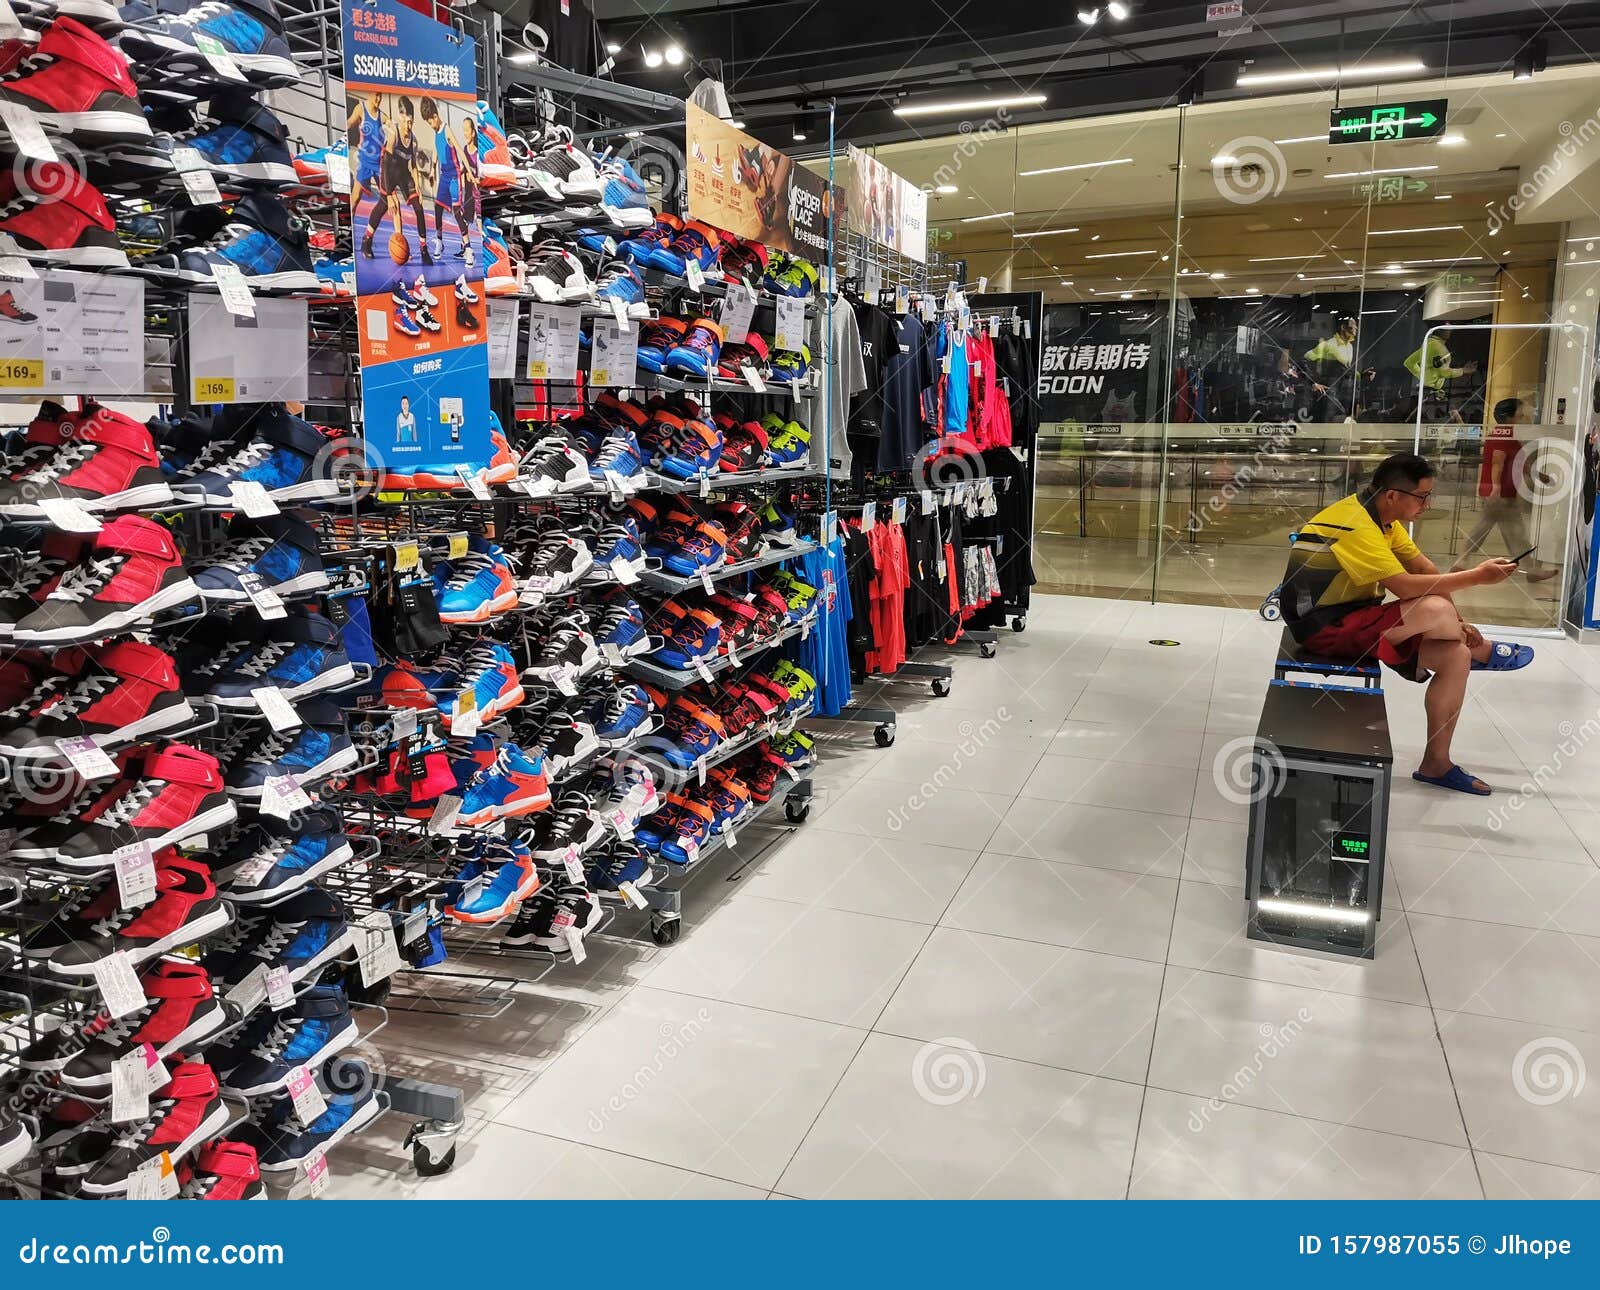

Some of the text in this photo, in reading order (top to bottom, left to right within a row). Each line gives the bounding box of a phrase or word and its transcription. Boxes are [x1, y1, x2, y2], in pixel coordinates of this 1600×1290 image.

[351, 8, 397, 33] 更多选择
[353, 53, 460, 88] SS500H 青少年篮球鞋
[796, 188, 821, 214] SPIDER
[794, 204, 814, 228] LACE
[412, 358, 443, 376] 如何购买
[1042, 343, 1151, 371] 敬请期待
[6, 366, 30, 379] 169
[207, 383, 224, 395] 169
[1039, 375, 1104, 394] SOON
[128, 857, 142, 868] 33
